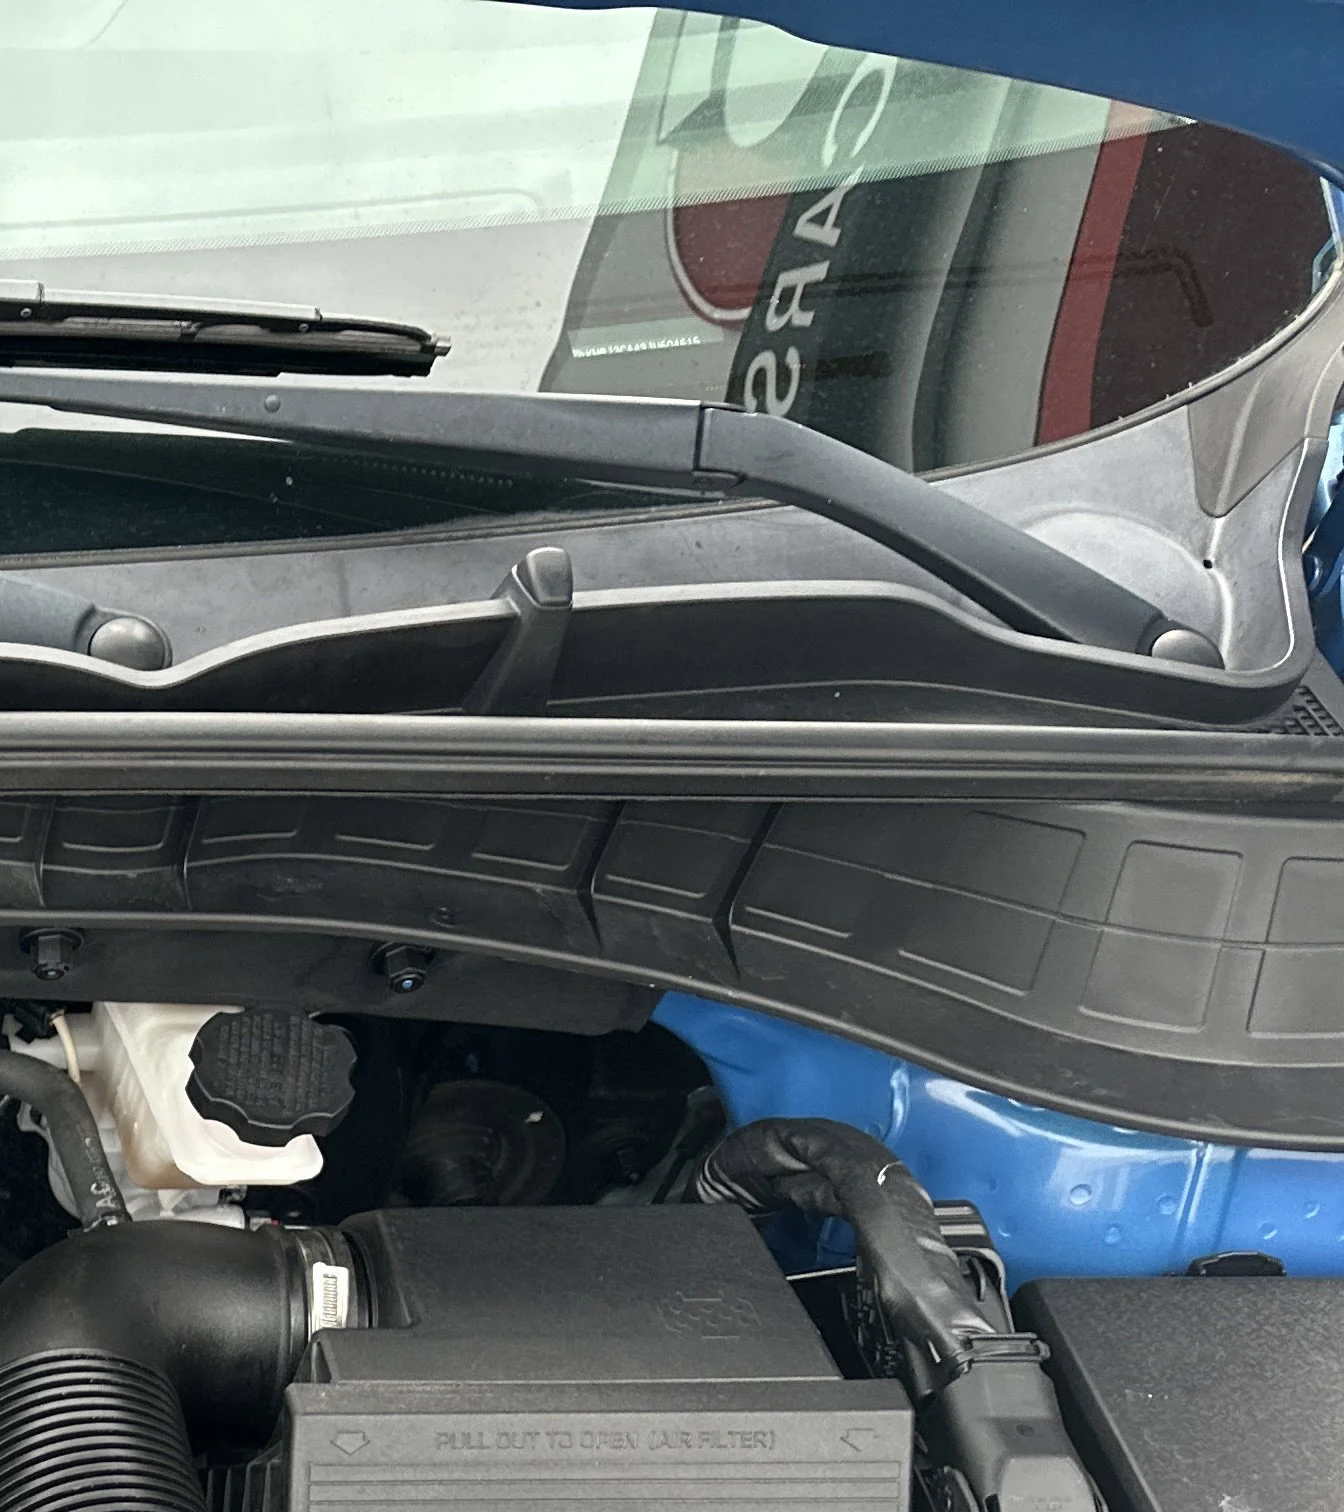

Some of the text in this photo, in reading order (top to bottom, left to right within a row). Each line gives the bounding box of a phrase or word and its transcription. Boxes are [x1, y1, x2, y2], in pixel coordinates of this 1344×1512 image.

[435, 1430, 777, 1451] PULL OUT TO OPEN (AIR FILTER)
